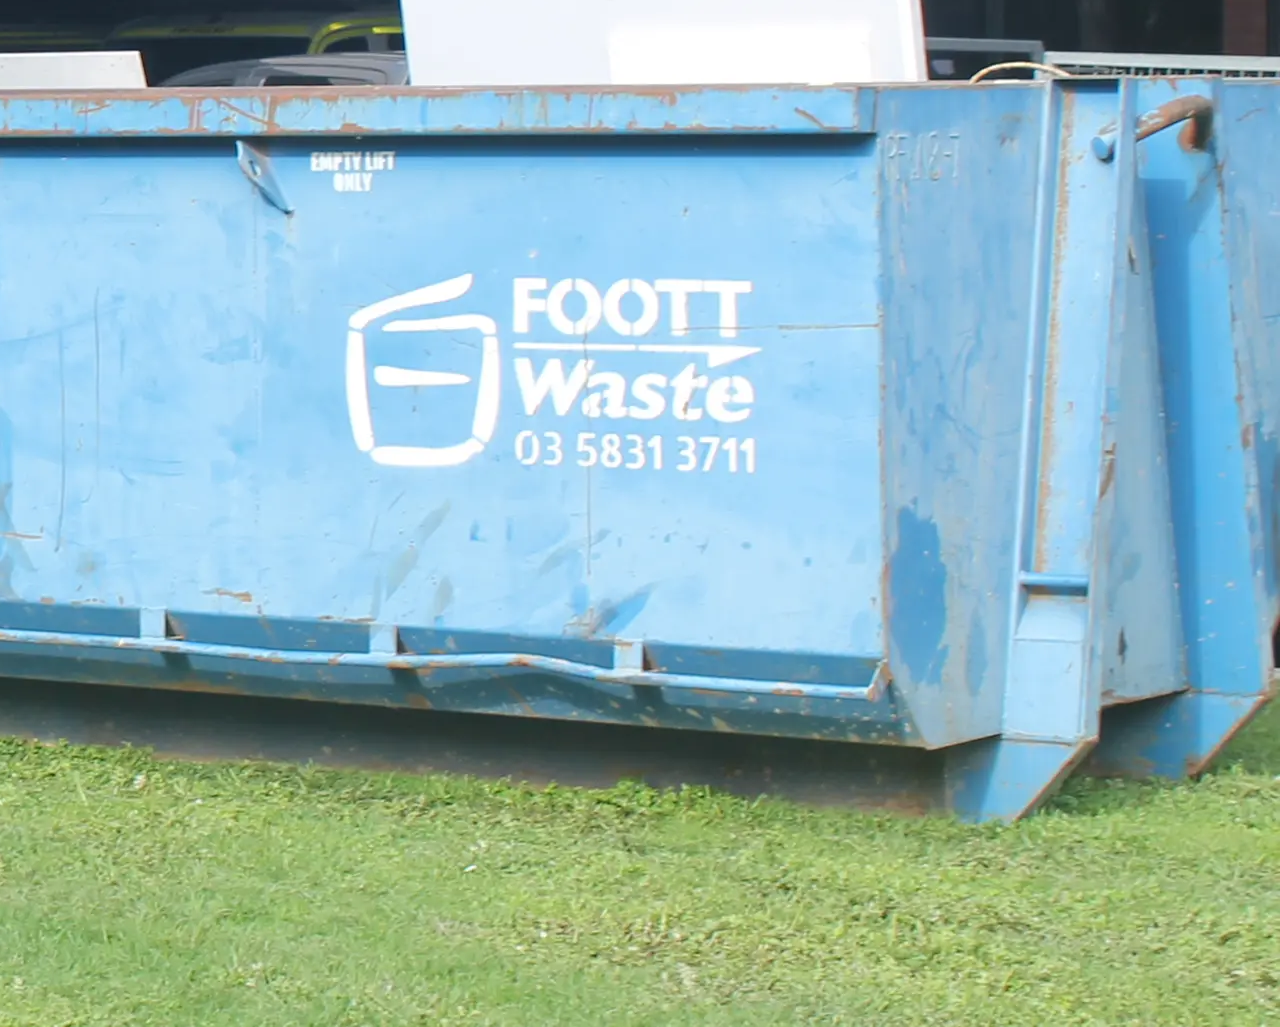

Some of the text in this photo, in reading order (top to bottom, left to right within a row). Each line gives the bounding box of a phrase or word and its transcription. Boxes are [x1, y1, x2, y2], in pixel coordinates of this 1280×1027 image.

[310, 151, 396, 172] EMPTY LIFT
[332, 172, 374, 192] ONLY
[512, 277, 753, 338] FOOTT
[513, 357, 756, 424] Waste
[515, 430, 757, 474] 03 5831 3711
